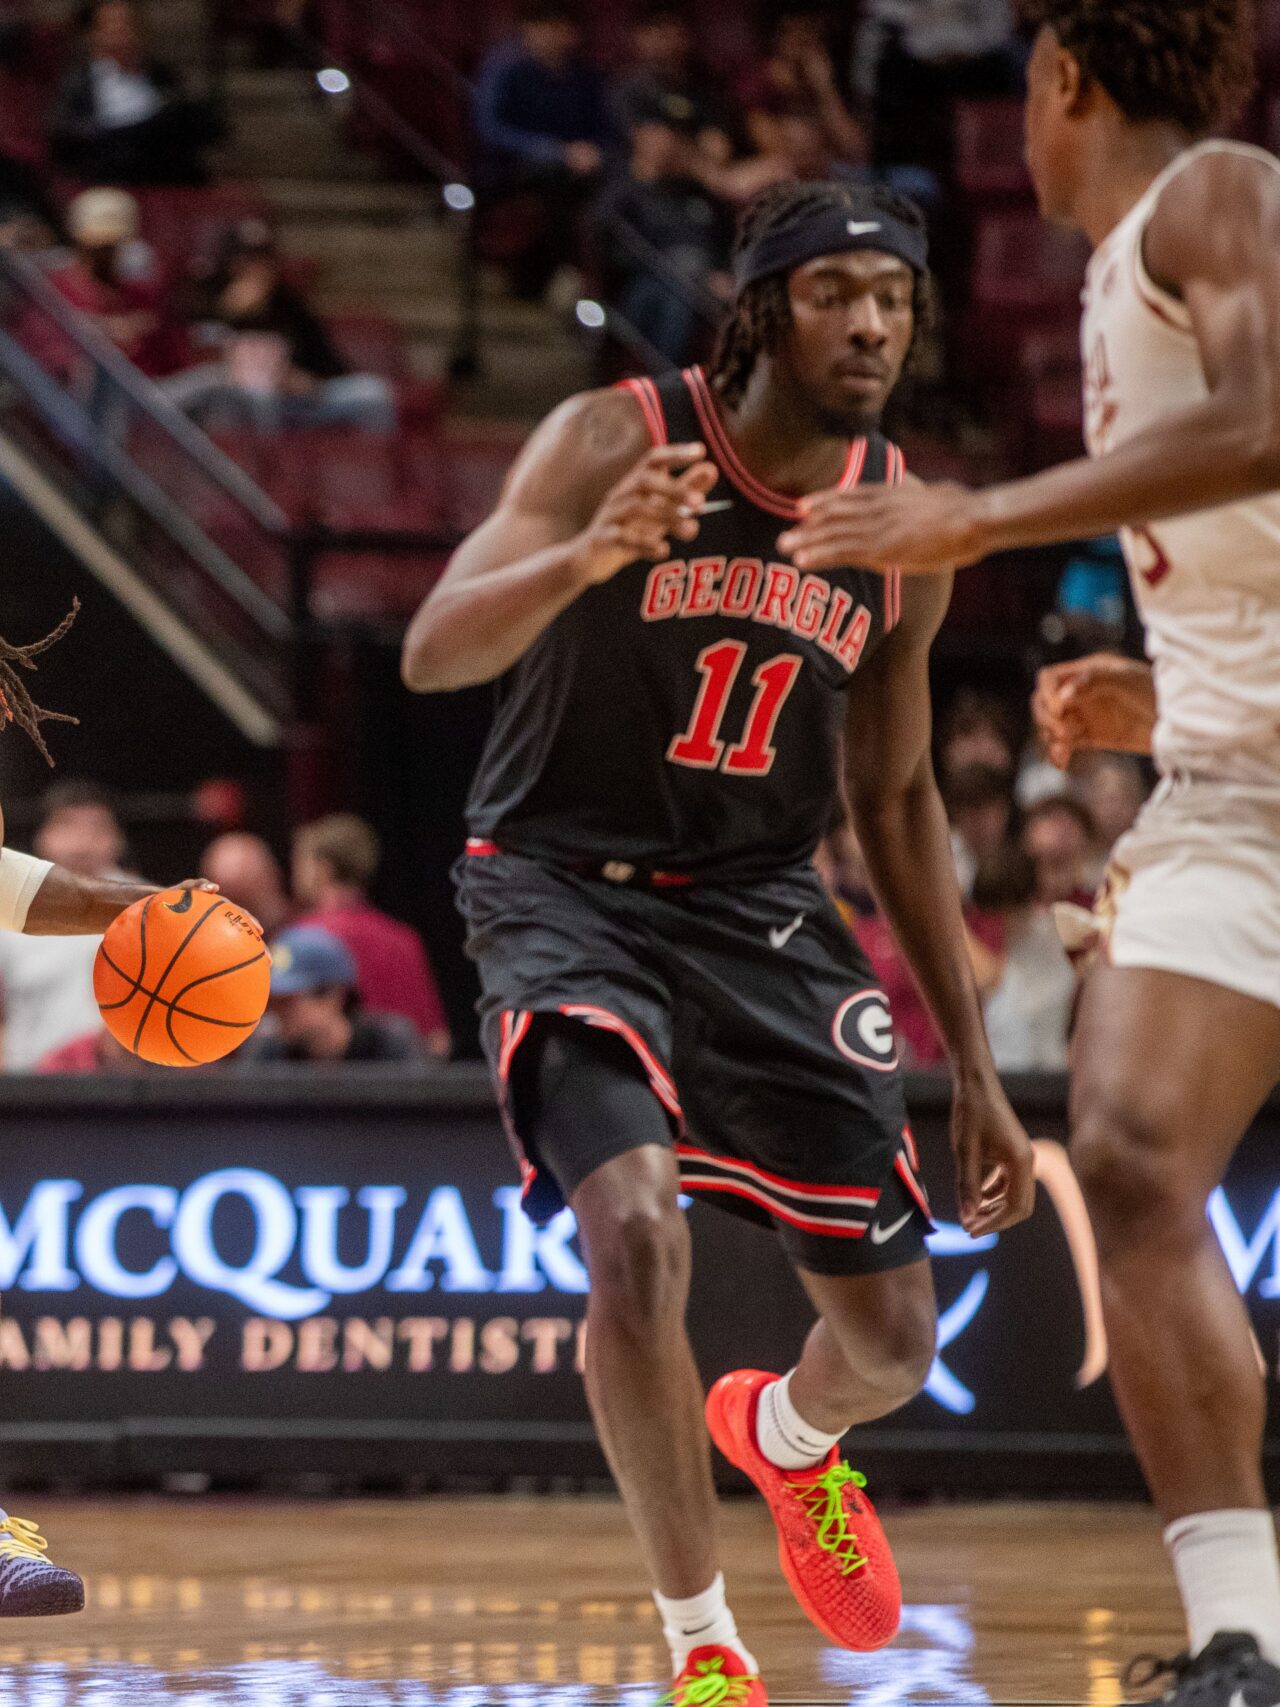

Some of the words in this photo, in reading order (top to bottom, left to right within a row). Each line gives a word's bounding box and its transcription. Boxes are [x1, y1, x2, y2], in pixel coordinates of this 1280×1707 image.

[640, 555, 872, 675] GEORGIA
[665, 638, 803, 776] 11
[241, 1315, 587, 1373] DENTIST
